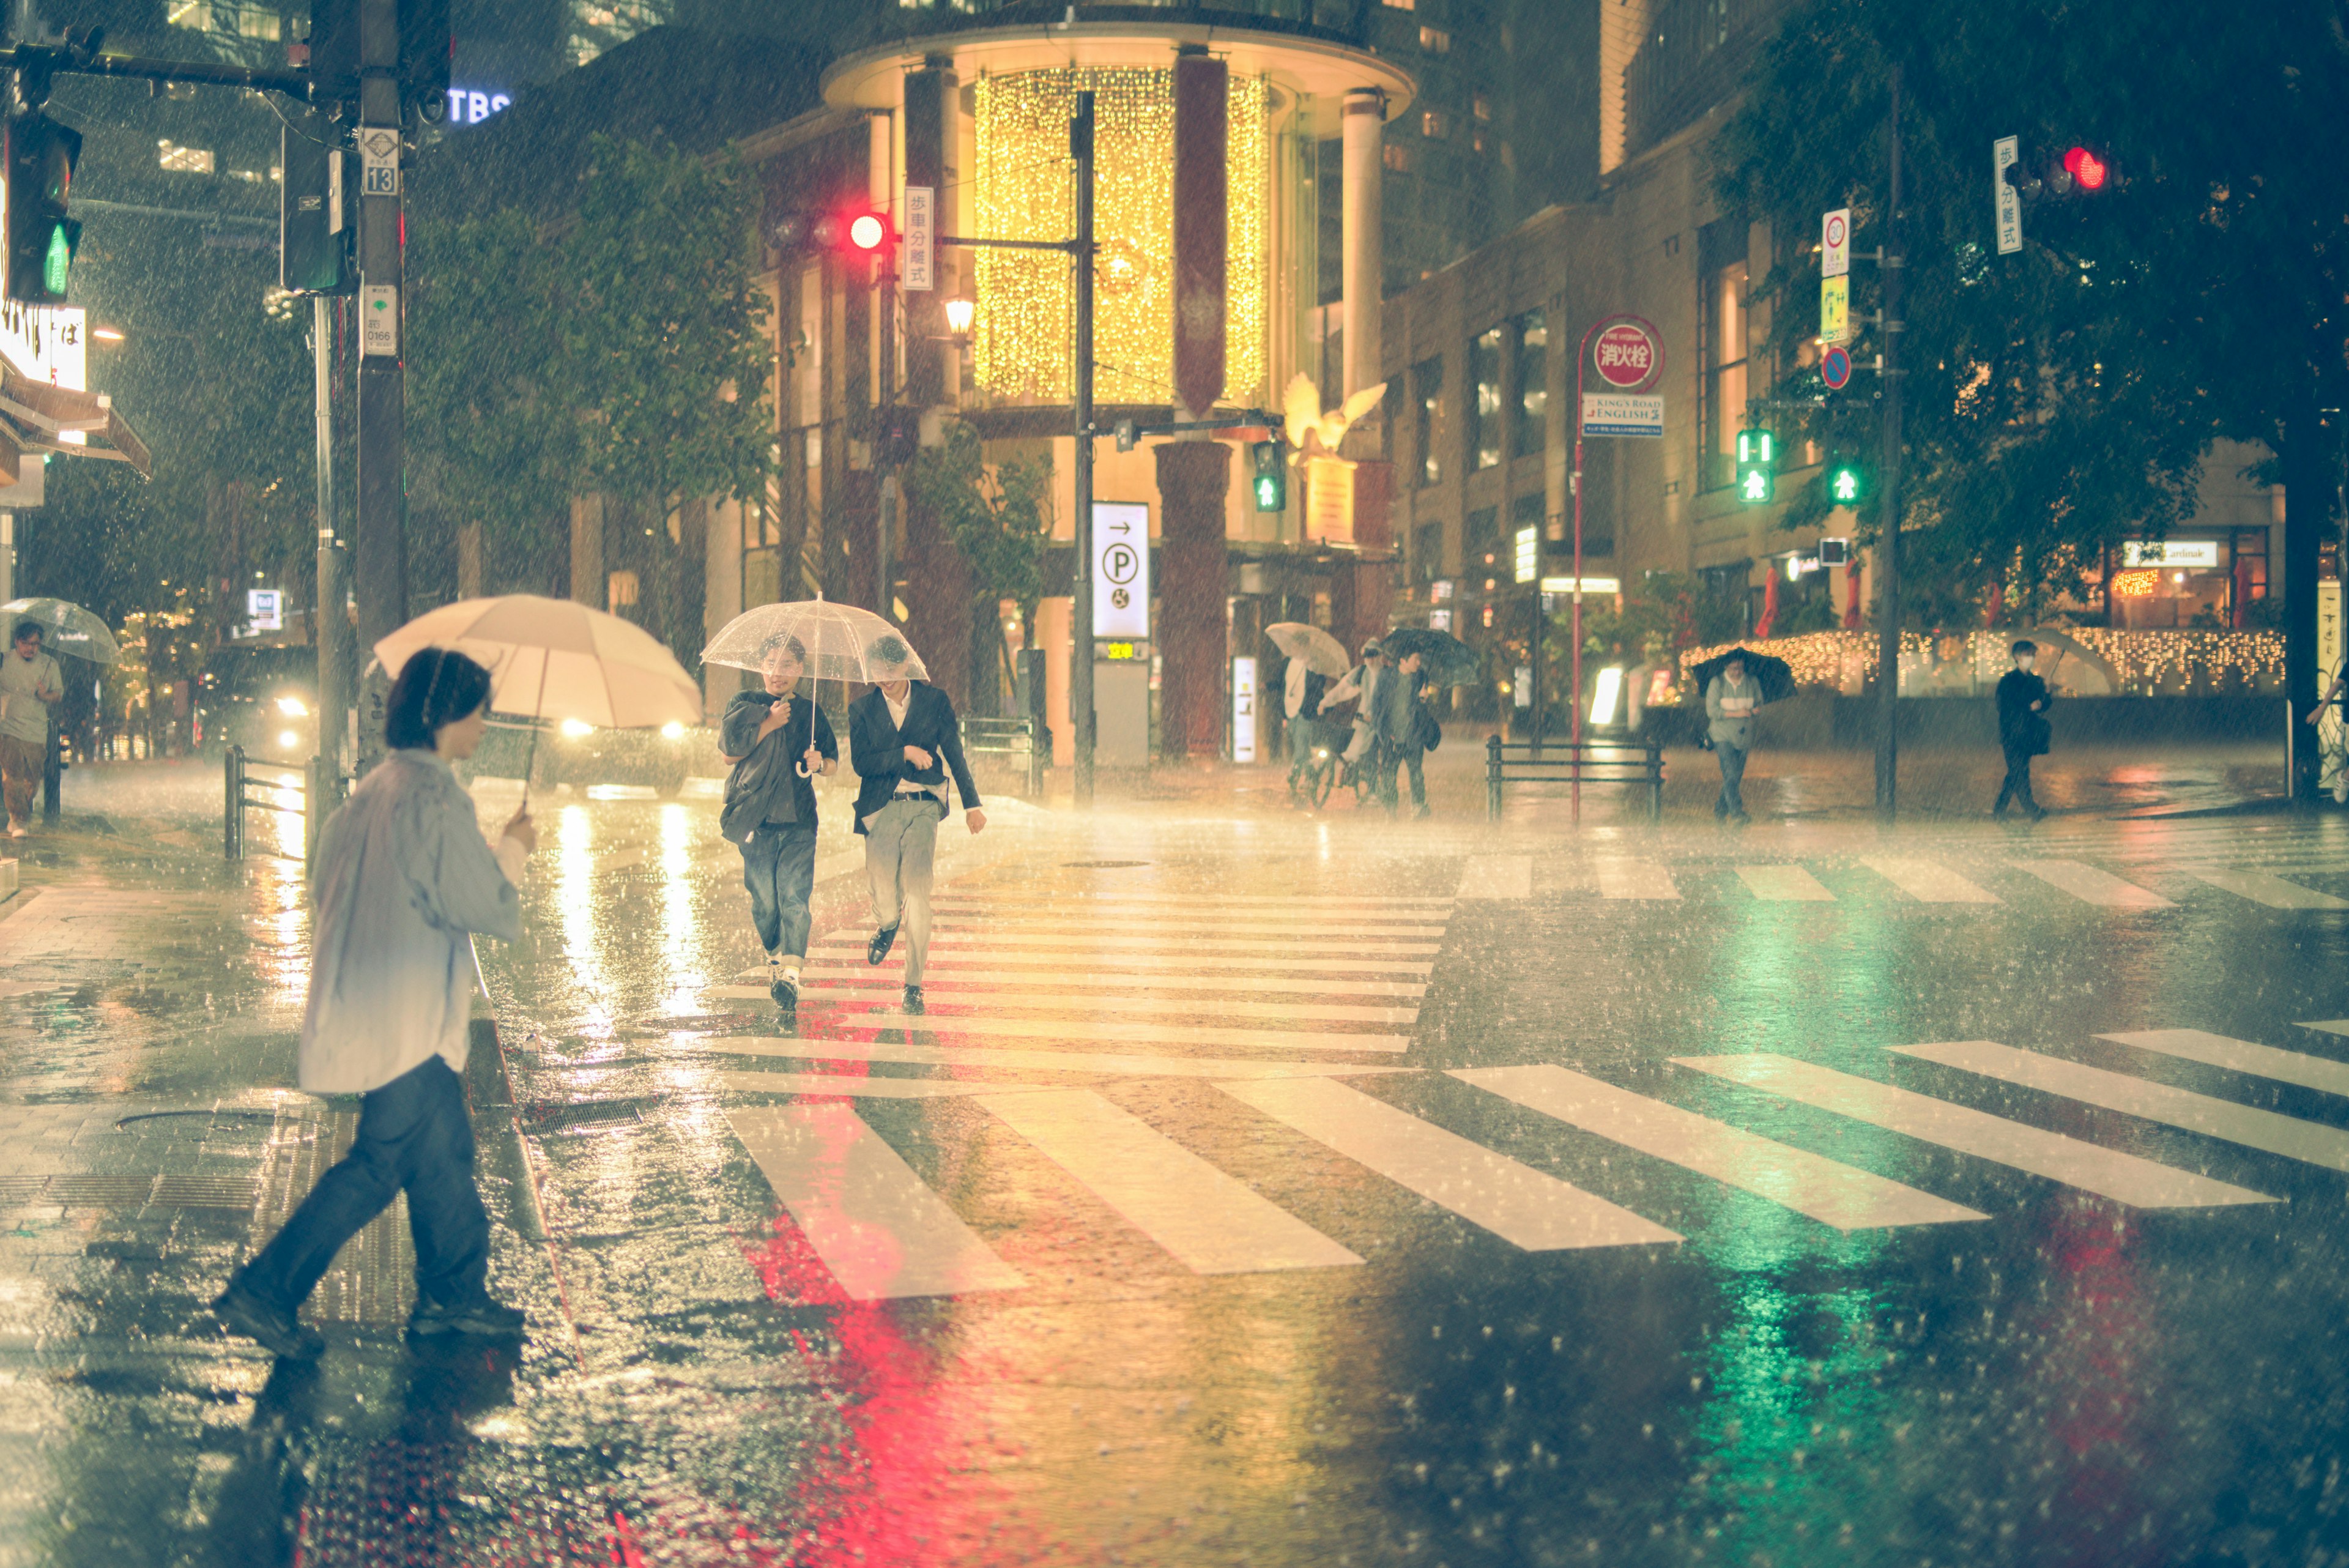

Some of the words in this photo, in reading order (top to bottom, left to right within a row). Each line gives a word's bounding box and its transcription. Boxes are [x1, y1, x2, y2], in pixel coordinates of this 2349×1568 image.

[370, 168, 392, 191] 13
[910, 195, 926, 283] 歩車分離式
[1831, 225, 1842, 240] 30
[368, 331, 391, 341] 0166
[1601, 343, 1649, 368] 消火栓
[1597, 408, 1649, 419] ENGLISH
[2165, 547, 2205, 558] ardinale
[1115, 552, 1129, 577] P
